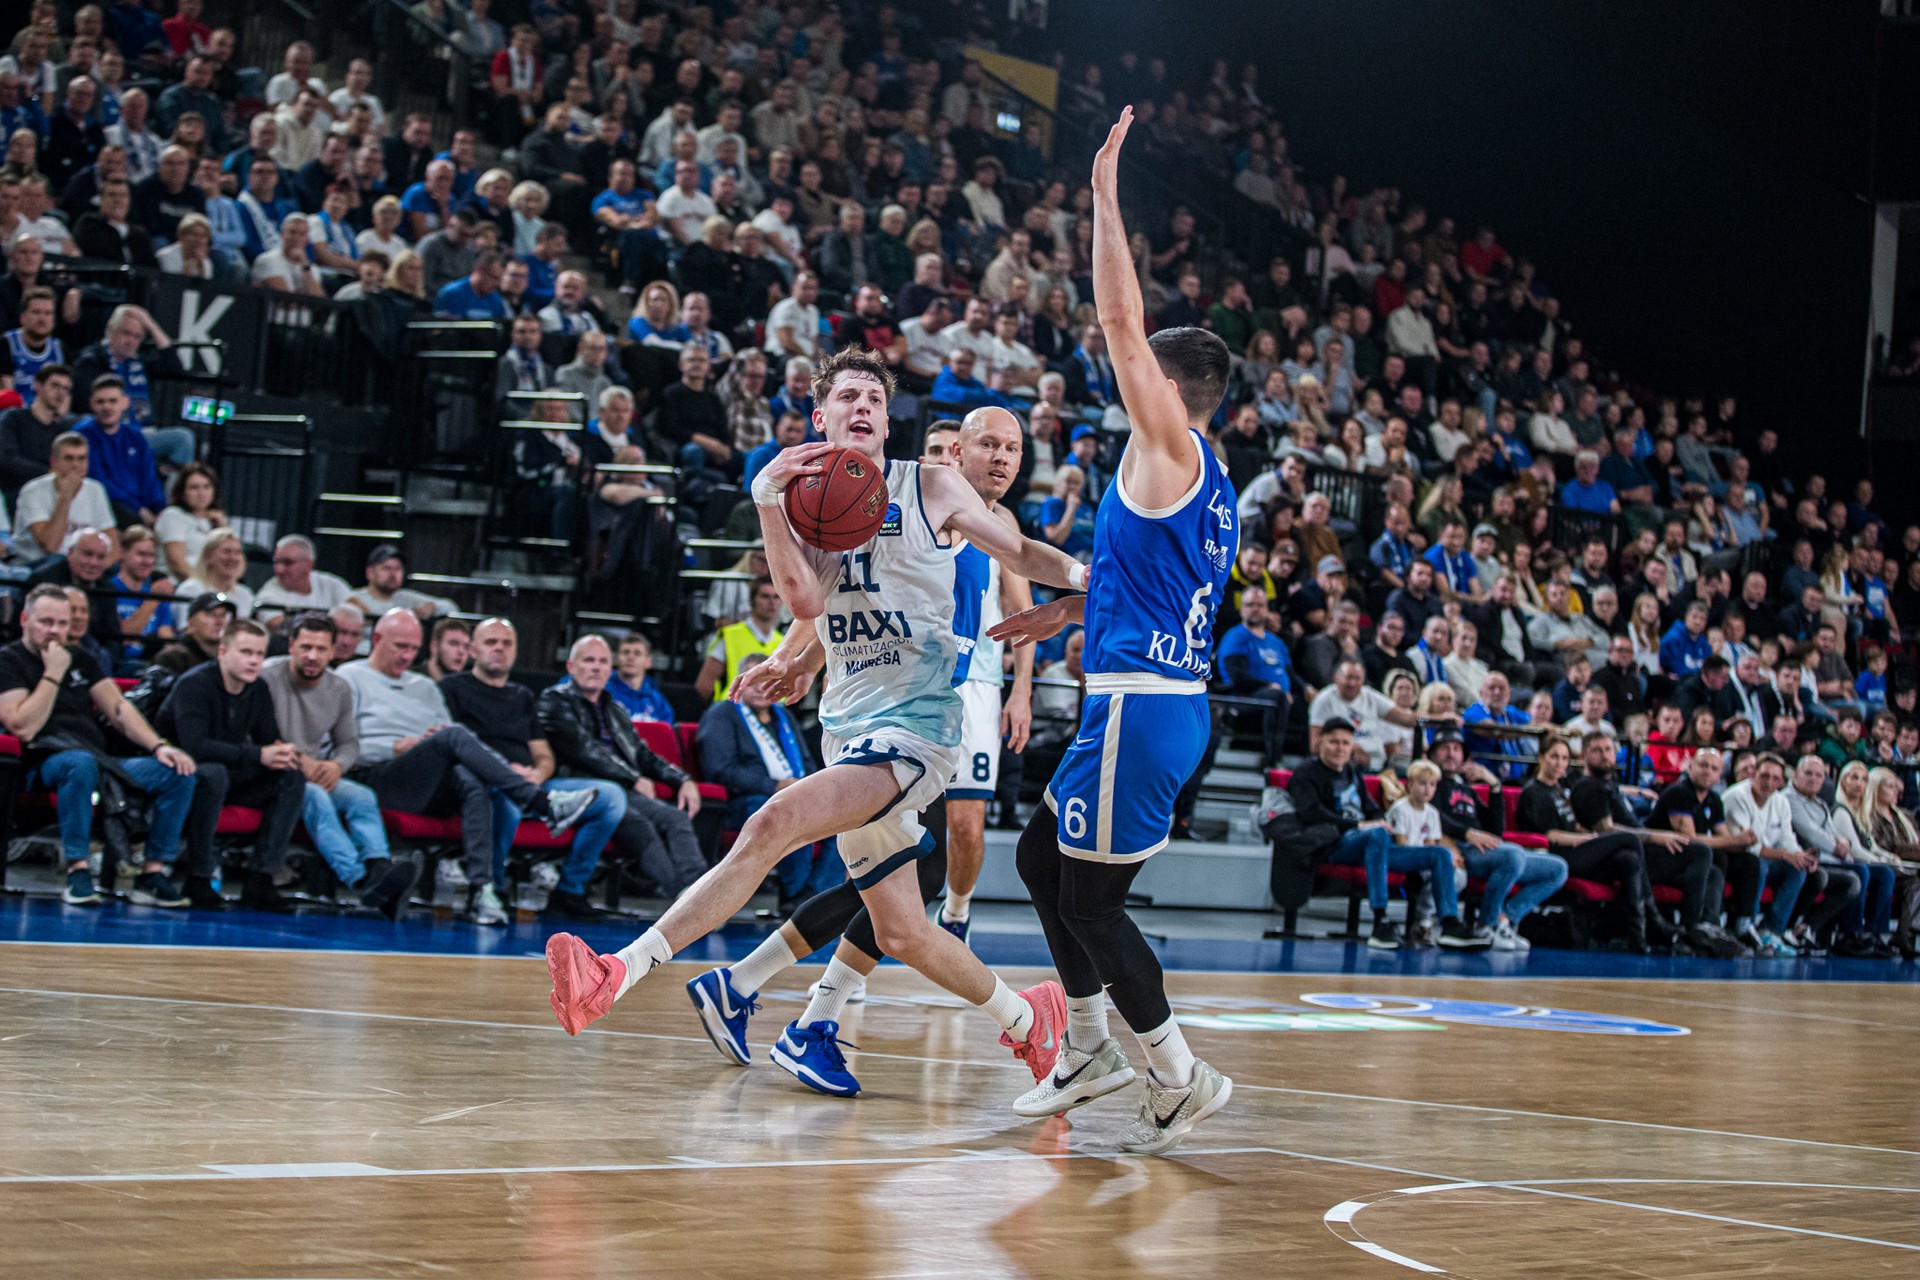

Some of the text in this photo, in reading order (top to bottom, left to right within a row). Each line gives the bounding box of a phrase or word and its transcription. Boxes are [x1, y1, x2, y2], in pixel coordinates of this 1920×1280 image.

[177, 290, 234, 377] K
[838, 551, 881, 593] 11
[827, 610, 912, 643] BAXI
[972, 752, 990, 783] 8
[1064, 796, 1088, 839] 6
